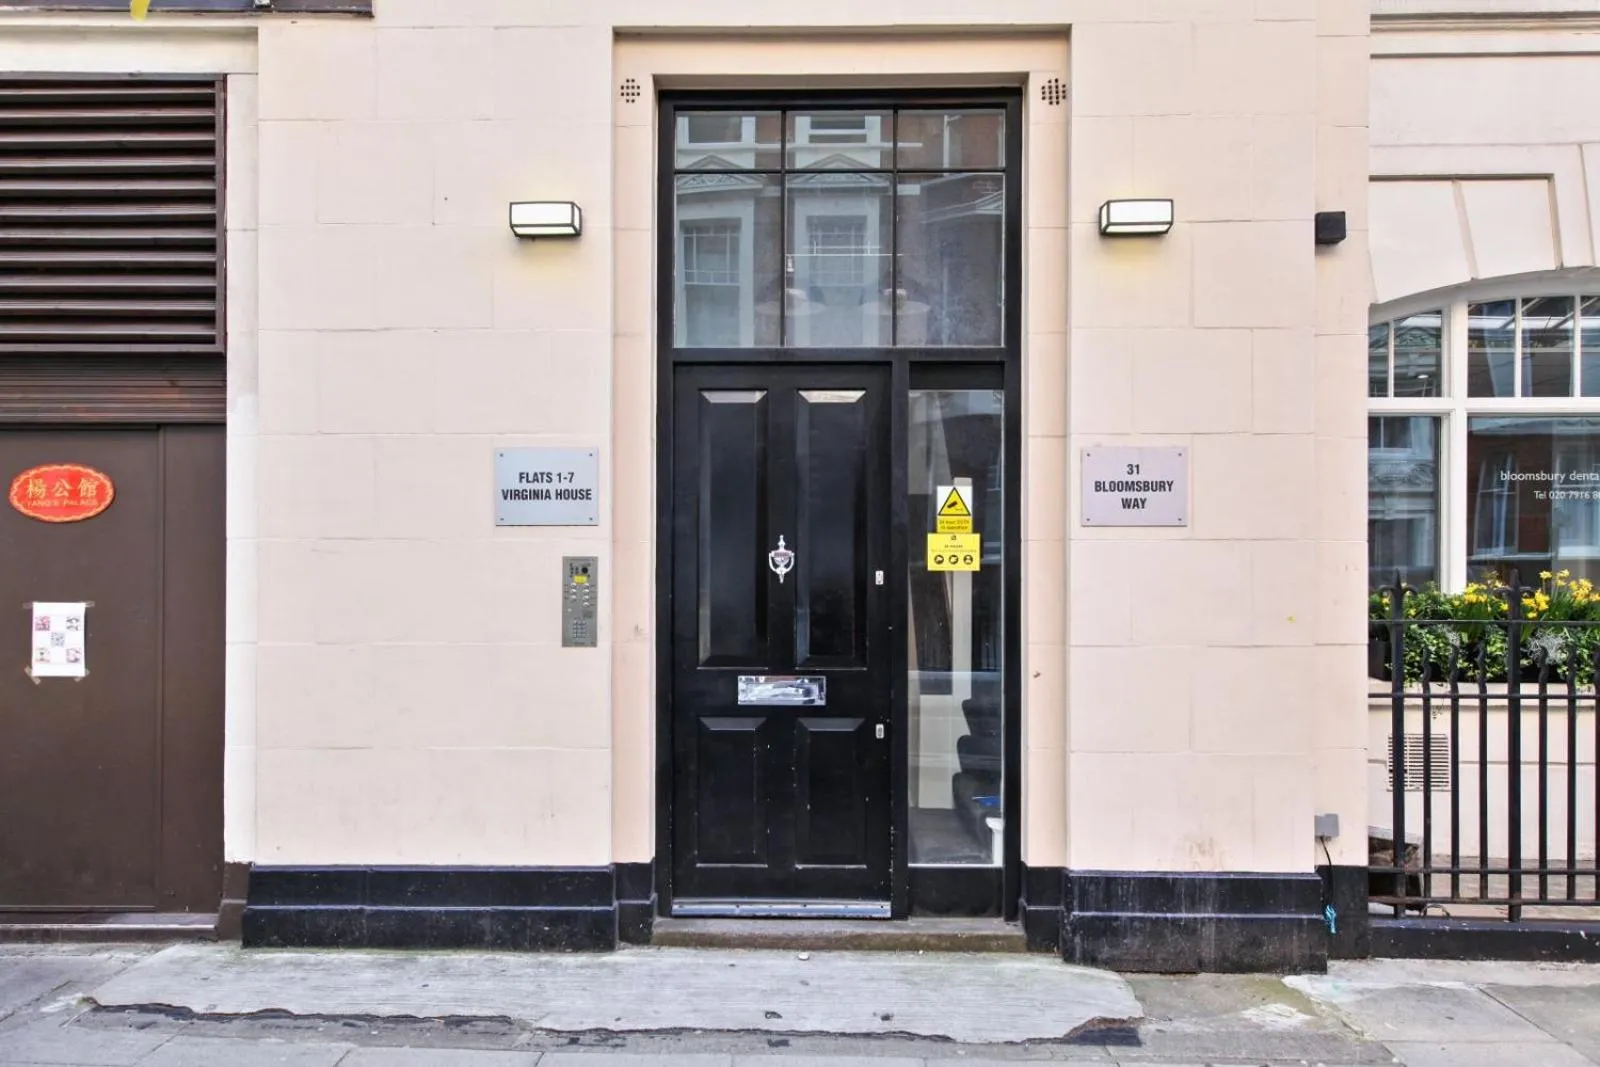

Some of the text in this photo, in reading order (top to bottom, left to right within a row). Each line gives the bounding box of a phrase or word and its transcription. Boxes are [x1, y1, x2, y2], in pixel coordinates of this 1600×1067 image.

[1126, 463, 1140, 475] 31
[518, 471, 575, 484] FLATS 1-7
[1500, 470, 1566, 483] bloomsbury
[1094, 480, 1174, 493] BLOOMSBURY
[501, 488, 592, 501] VIRGINIA HOUSE
[1533, 490, 1547, 500] Tel
[1548, 490, 1566, 500] 020
[1121, 497, 1147, 510] WAY
